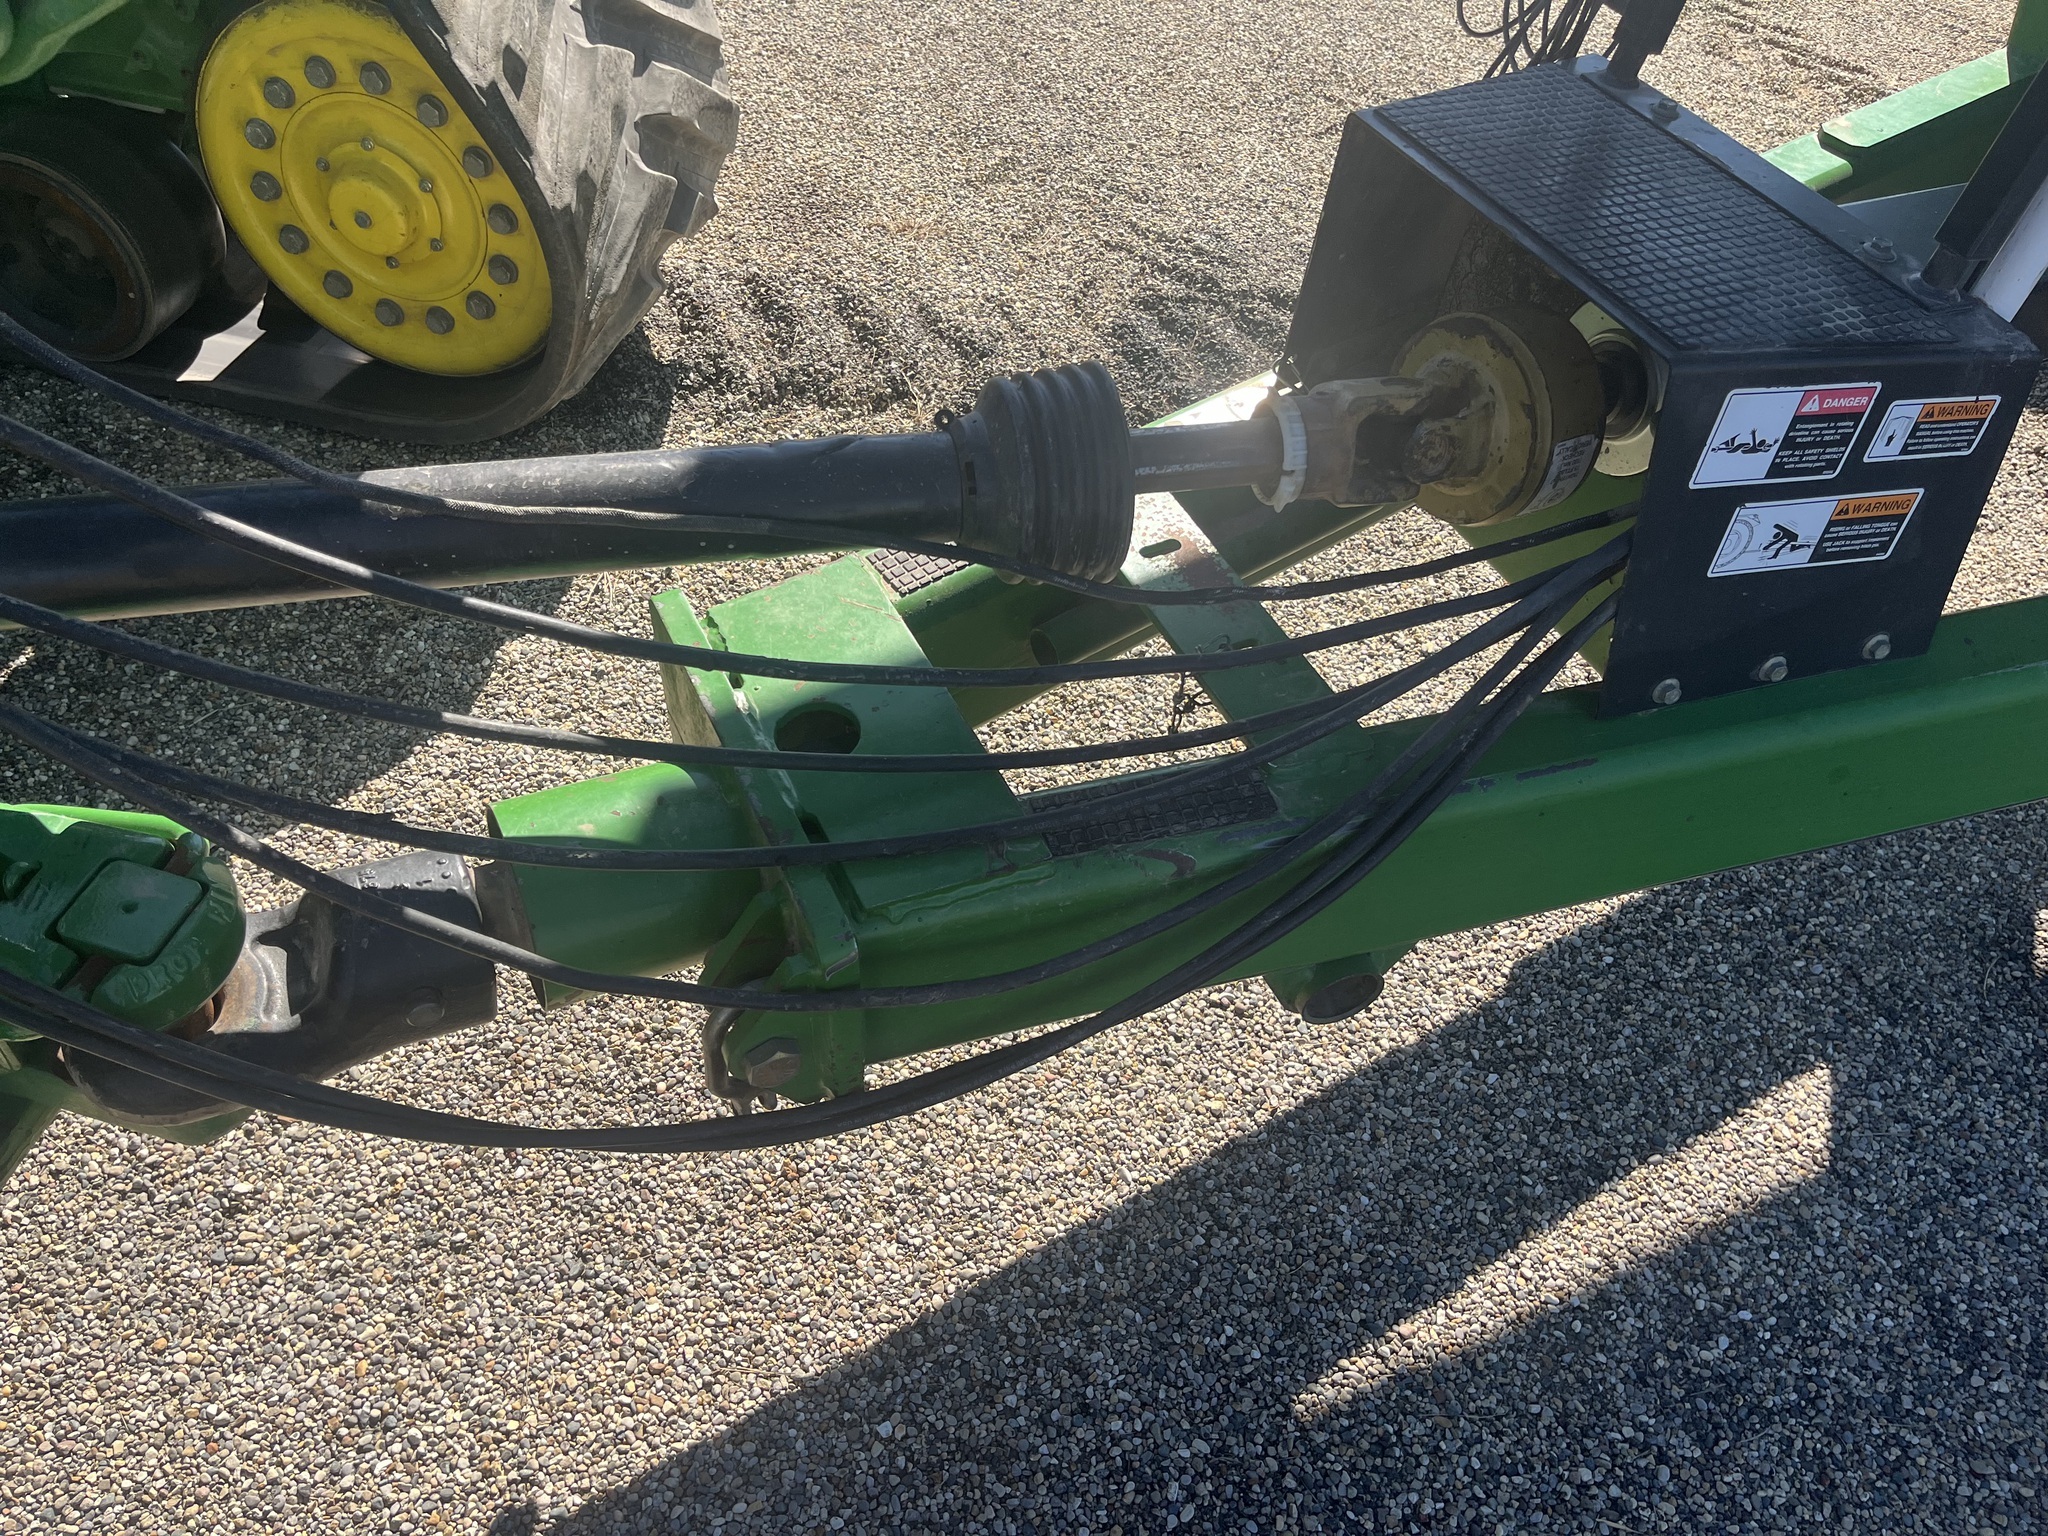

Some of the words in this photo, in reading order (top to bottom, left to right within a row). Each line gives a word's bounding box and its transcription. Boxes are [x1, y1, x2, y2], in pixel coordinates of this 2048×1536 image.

[1823, 397, 1868, 408] DANGER
[1937, 404, 1989, 417] WARNING
[1852, 499, 1911, 514] WARNING
